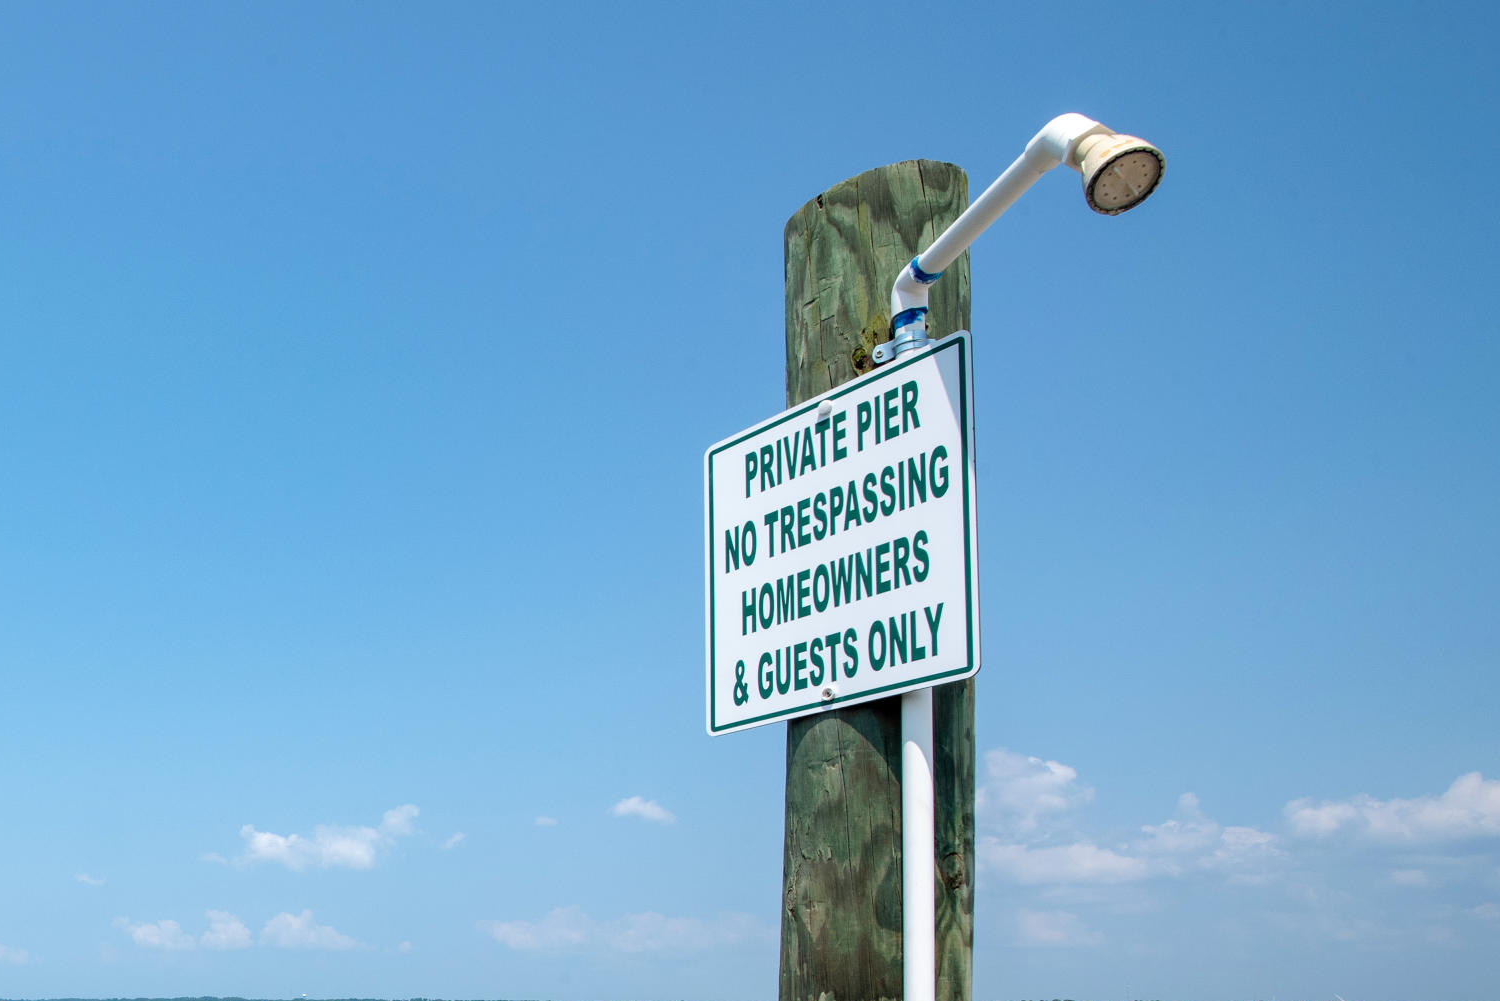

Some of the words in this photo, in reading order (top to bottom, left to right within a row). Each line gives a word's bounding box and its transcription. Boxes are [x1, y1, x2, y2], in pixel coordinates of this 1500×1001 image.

[745, 417, 847, 499] PRIVATE
[857, 380, 921, 452] PIER
[725, 521, 758, 574] NO
[764, 445, 950, 558] TRESPASSING
[742, 530, 930, 636] HOMEOWNERS
[733, 660, 750, 707] &
[757, 628, 859, 700] GUESTS
[868, 602, 944, 672] ONLY
